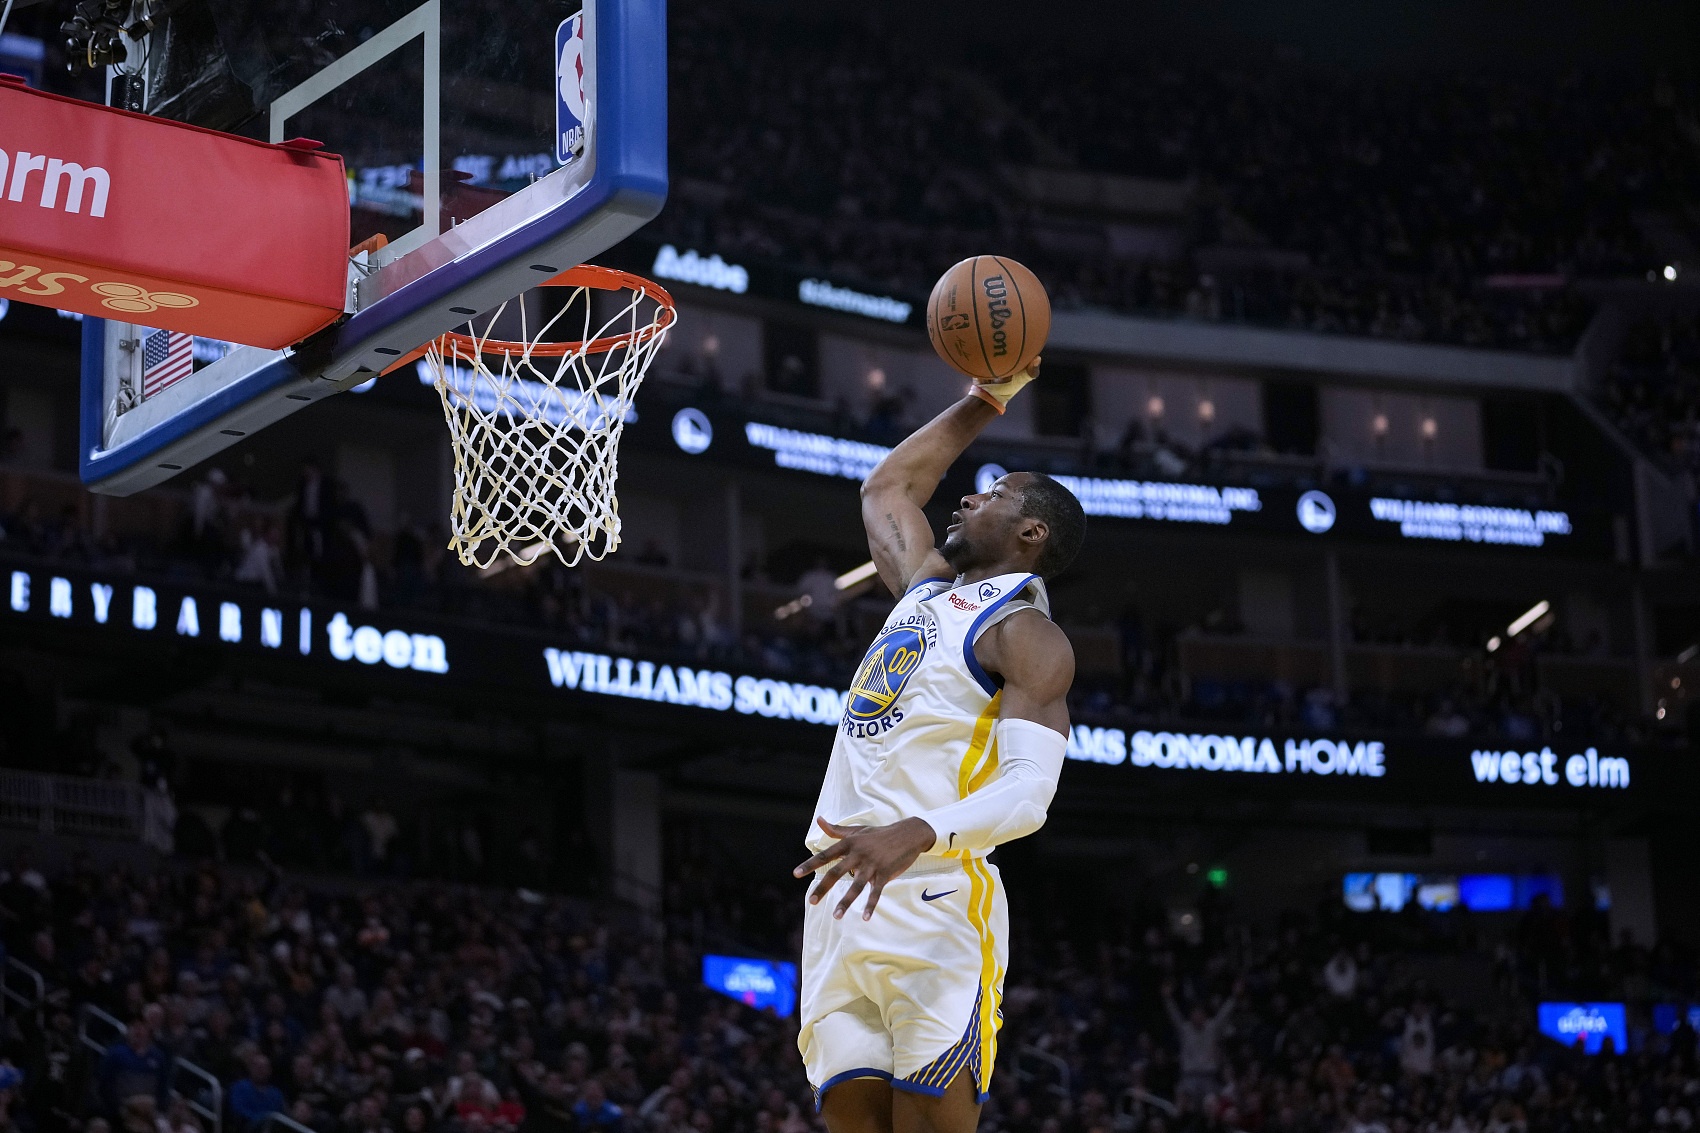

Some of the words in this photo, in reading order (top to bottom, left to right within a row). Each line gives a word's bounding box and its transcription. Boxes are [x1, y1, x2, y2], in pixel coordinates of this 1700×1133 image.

[653, 244, 749, 294] Adobe
[983, 274, 1012, 357] Wilson
[327, 611, 449, 674] teen
[880, 615, 926, 635] GOLDEN
[888, 647, 918, 675] 00
[544, 648, 732, 711] WILLIAMS
[734, 675, 848, 726] SONOM
[1131, 730, 1282, 773] SONOMA
[1284, 738, 1386, 777] HOME
[1471, 746, 1559, 786] west
[1565, 747, 1630, 788] elm
